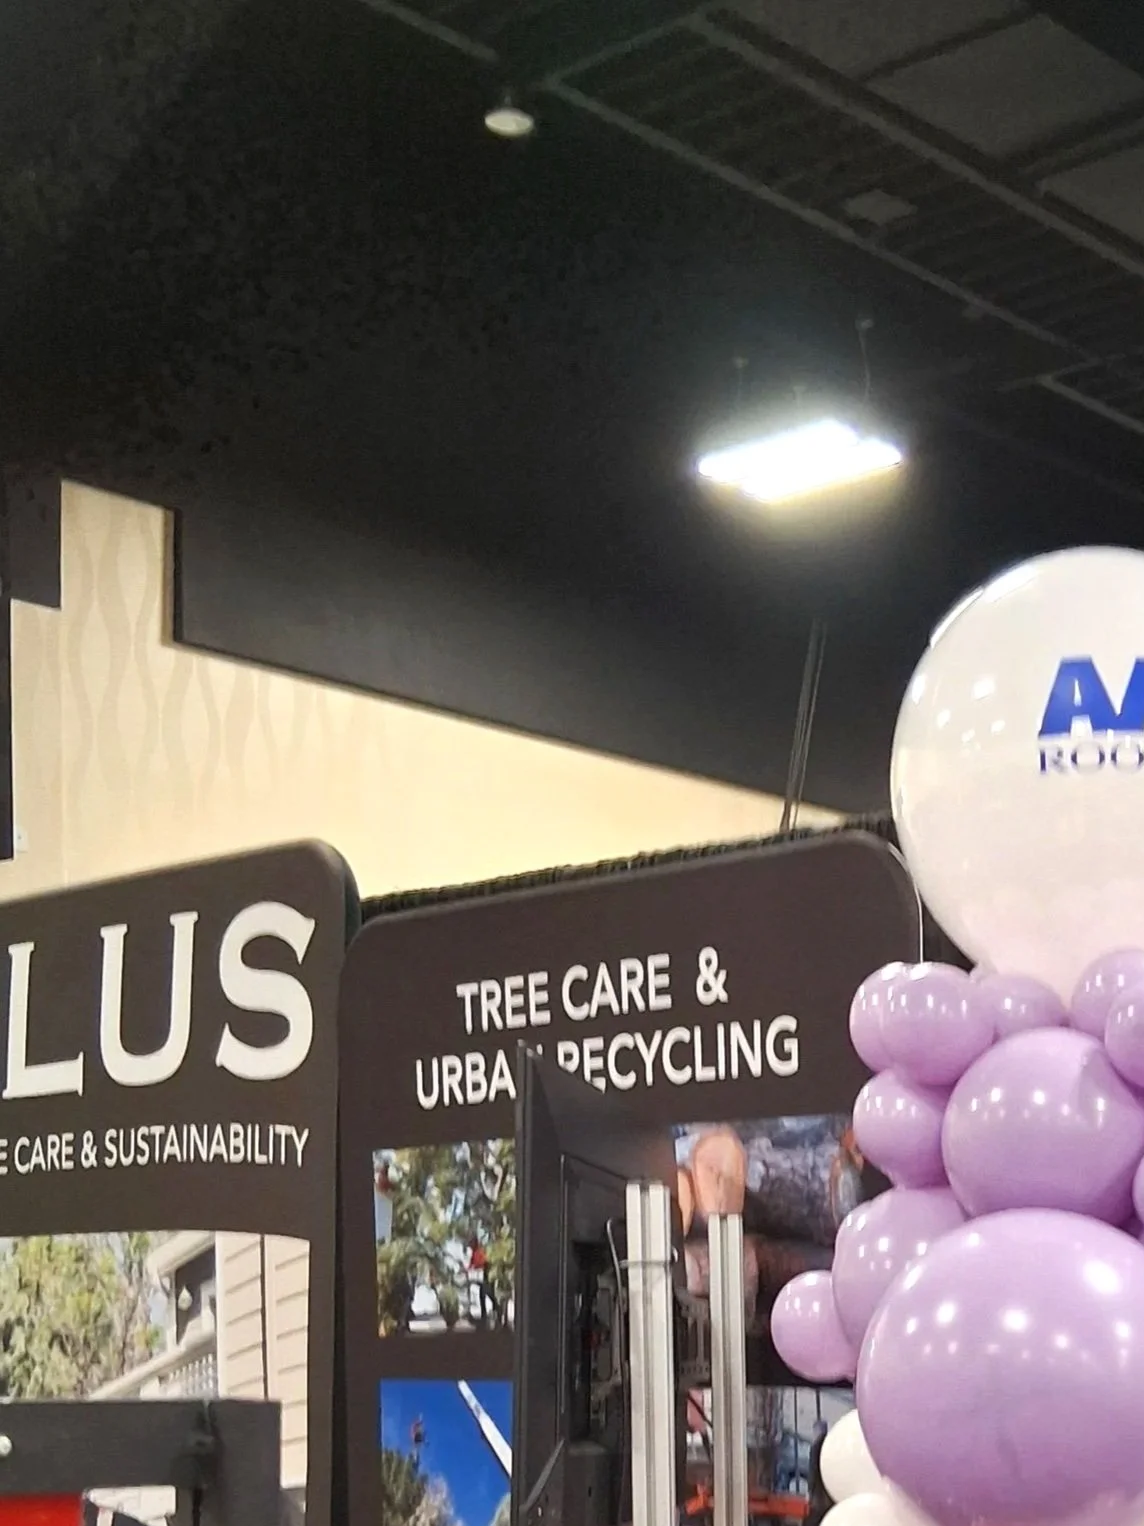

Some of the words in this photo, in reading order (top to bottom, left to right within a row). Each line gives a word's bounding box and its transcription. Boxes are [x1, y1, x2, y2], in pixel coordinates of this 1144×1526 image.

[456, 971, 551, 1035] TREE
[561, 953, 672, 1021] CARE
[695, 946, 729, 1006] &
[415, 1041, 543, 1111] URBA
[13, 1132, 74, 1174] CARE
[80, 1130, 98, 1169] &
[104, 1122, 310, 1168] SUSTAINABILITY
